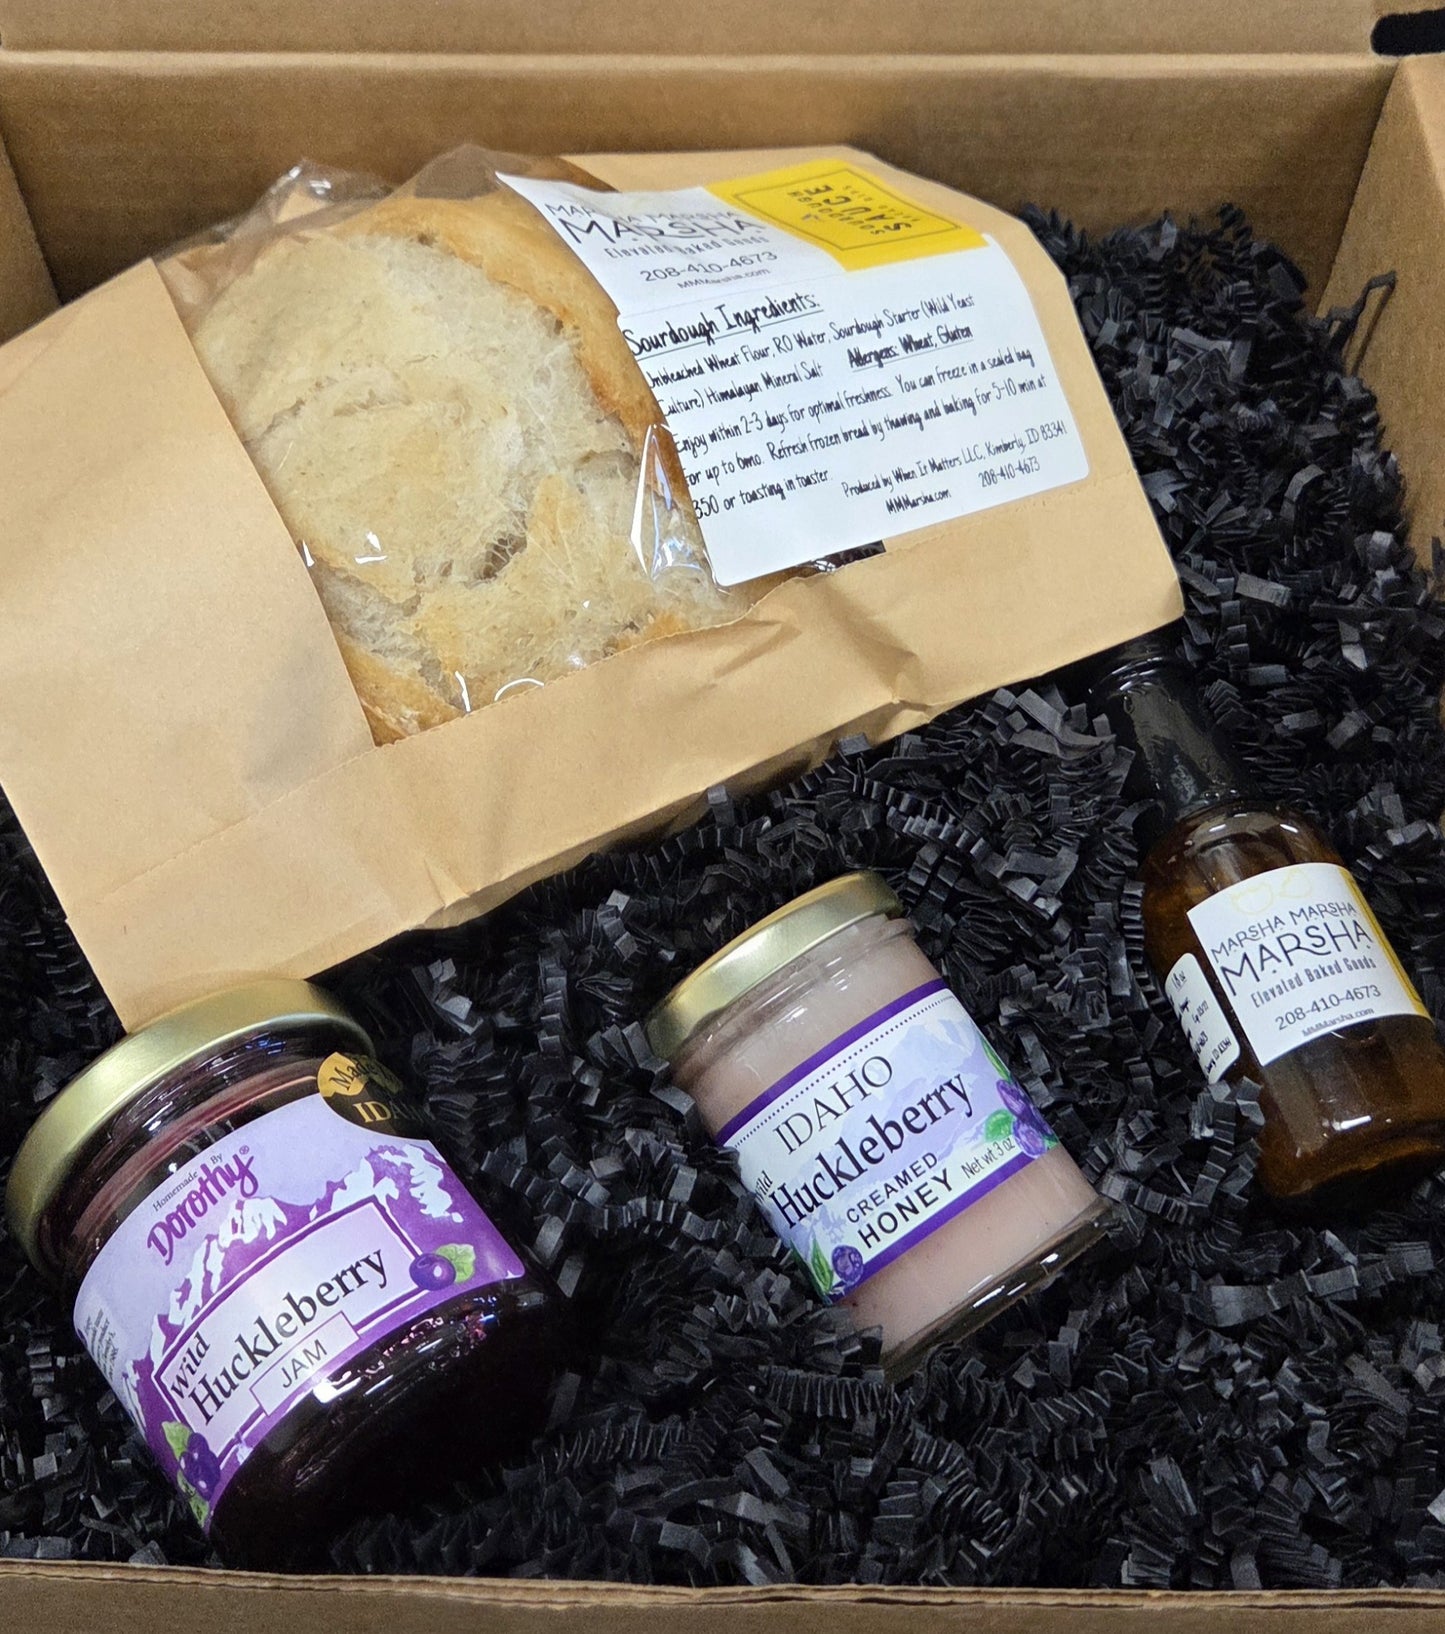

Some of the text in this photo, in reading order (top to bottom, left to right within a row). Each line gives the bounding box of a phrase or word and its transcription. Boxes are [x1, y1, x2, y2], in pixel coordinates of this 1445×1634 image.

[545, 203, 640, 226] MARHA
[558, 217, 766, 244] MARSHA
[805, 184, 913, 232] SAUCE
[640, 250, 778, 282] 208-410-4673
[622, 292, 821, 356] Sourdough Ingredients:
[704, 350, 741, 373] Wheat
[740, 345, 776, 363] Flour,
[773, 334, 793, 352] RO
[793, 330, 832, 350] Water,
[828, 313, 885, 340] Sourdough
[882, 305, 920, 328] Starter
[919, 294, 949, 319] (Wild
[948, 292, 976, 309] Yeast
[897, 331, 938, 355] Wheat,
[936, 325, 974, 345] Gluten
[704, 380, 763, 404] Himalayan
[760, 364, 803, 391] Mineral
[800, 360, 824, 381] Salt
[708, 422, 742, 443] within
[740, 411, 763, 435] 2-3
[764, 410, 789, 434] days
[788, 403, 805, 422] for
[808, 396, 846, 424] optimal
[894, 373, 919, 394] You
[918, 371, 936, 388] can
[936, 362, 968, 384] freeze
[968, 358, 979, 375] in
[979, 359, 987, 372] a
[987, 347, 1016, 370] sealed
[1014, 344, 1036, 368] bag
[683, 374, 1048, 487] or up to 6mo. Refresh frozen bread by thawing and baking for 5-10 min at
[841, 471, 882, 498] Produced
[882, 470, 895, 493] by
[892, 463, 918, 485] When
[927, 454, 963, 475] Matters
[1024, 427, 1040, 446] ID
[1038, 419, 1068, 441] 83341
[692, 493, 720, 520] 350
[723, 495, 736, 511] or
[739, 481, 786, 506] toasting
[785, 475, 796, 491] in
[978, 456, 1041, 488] 208-410-4673
[1210, 901, 1357, 964] MARSHA MARSHA
[1220, 919, 1374, 997] MARSHA
[1250, 954, 1378, 1009] Elevated Baked Goods
[1274, 984, 1382, 1031] 208-410-4673
[352, 1095, 420, 1125] IDA
[772, 1054, 894, 1155] IDAHO
[769, 1073, 974, 1229] Huckleberry
[960, 1137, 1016, 1180] Net wt 3 oz
[152, 1153, 224, 1213] Homemade By
[846, 1151, 938, 1224] CREAMED
[857, 1169, 954, 1249] HONEY
[187, 1247, 389, 1427] Huckleberry
[281, 1338, 328, 1389] JAM
